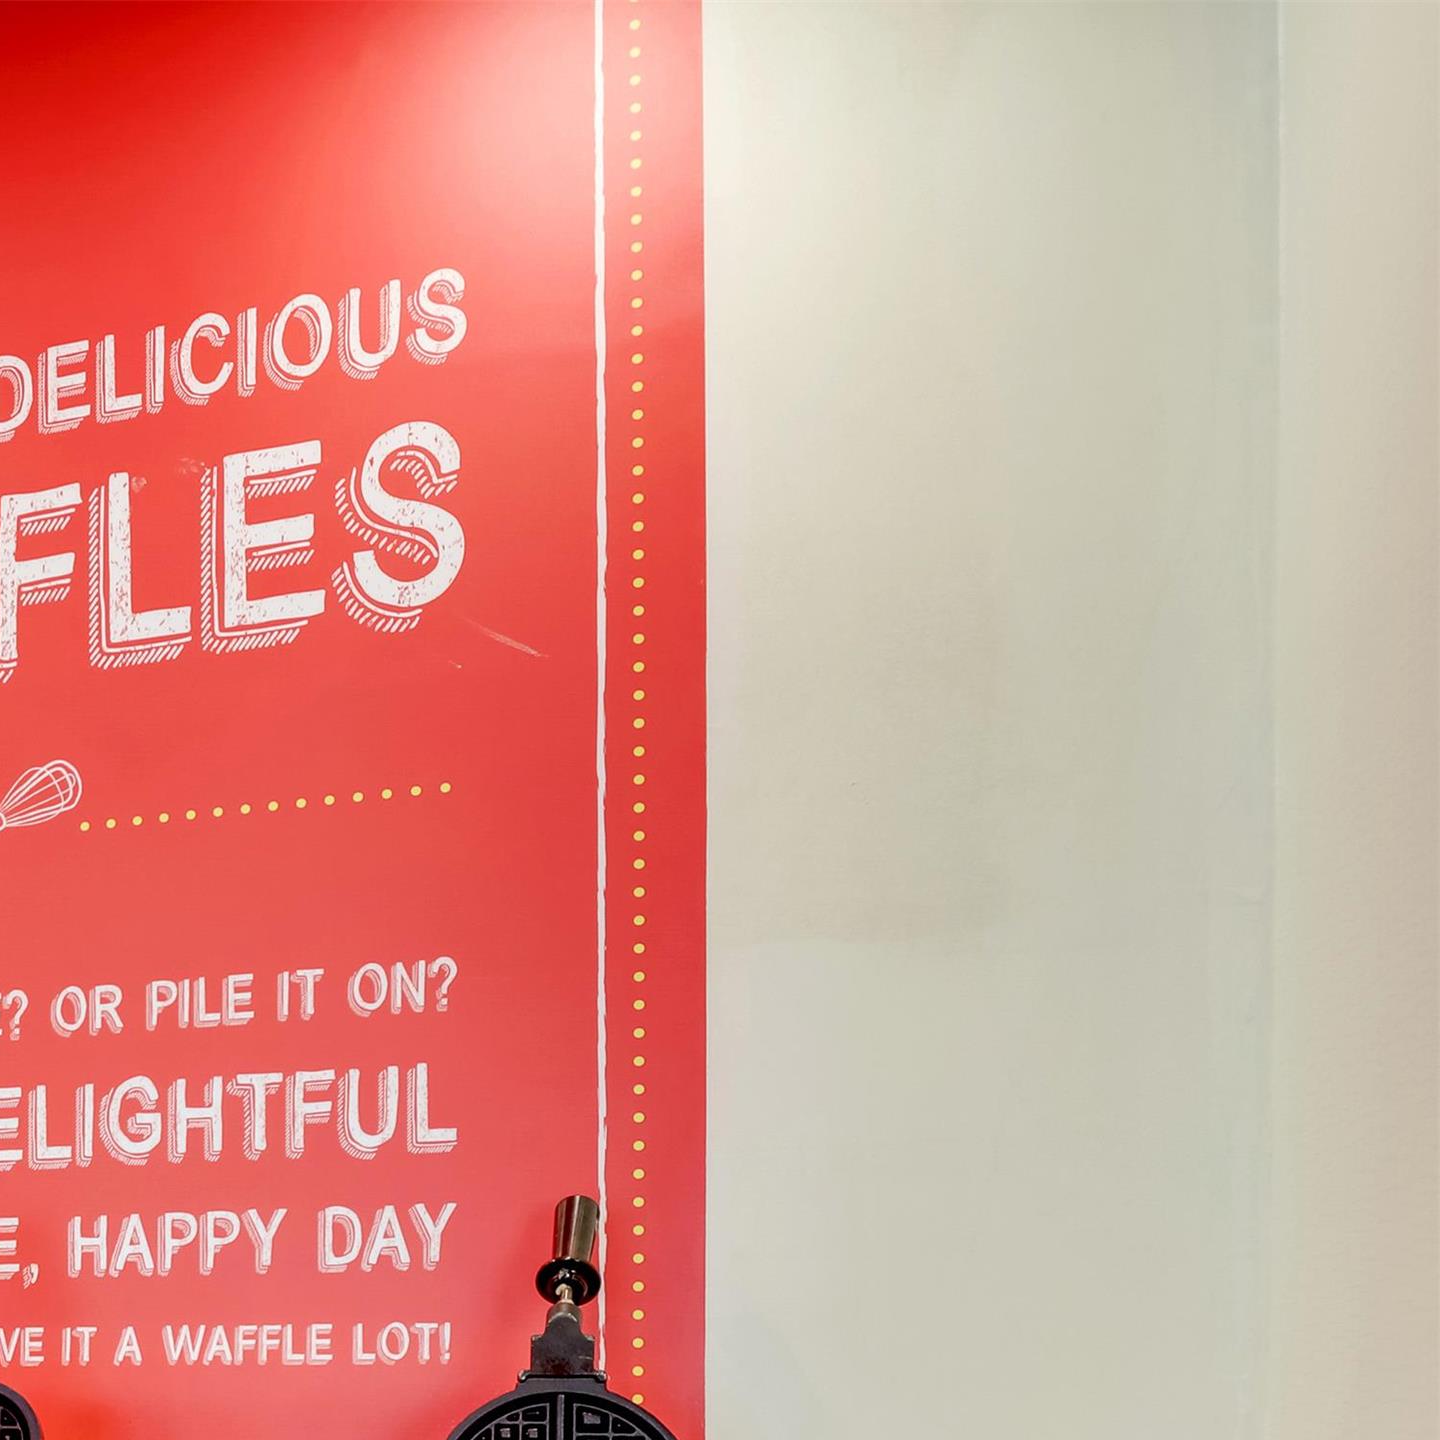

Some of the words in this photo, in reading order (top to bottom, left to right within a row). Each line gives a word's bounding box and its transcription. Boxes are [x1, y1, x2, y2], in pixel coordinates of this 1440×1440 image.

[51, 985, 124, 1037] OR
[146, 973, 255, 1031] PILE
[277, 968, 324, 1021] IT
[347, 956, 458, 1017] ON?
[68, 1208, 287, 1278] HAPPY
[317, 1203, 457, 1274] DAY
[62, 1326, 97, 1366] IT
[114, 1326, 142, 1366] A
[163, 1324, 333, 1366] WAFFLE
[352, 1321, 451, 1365] LOT!
